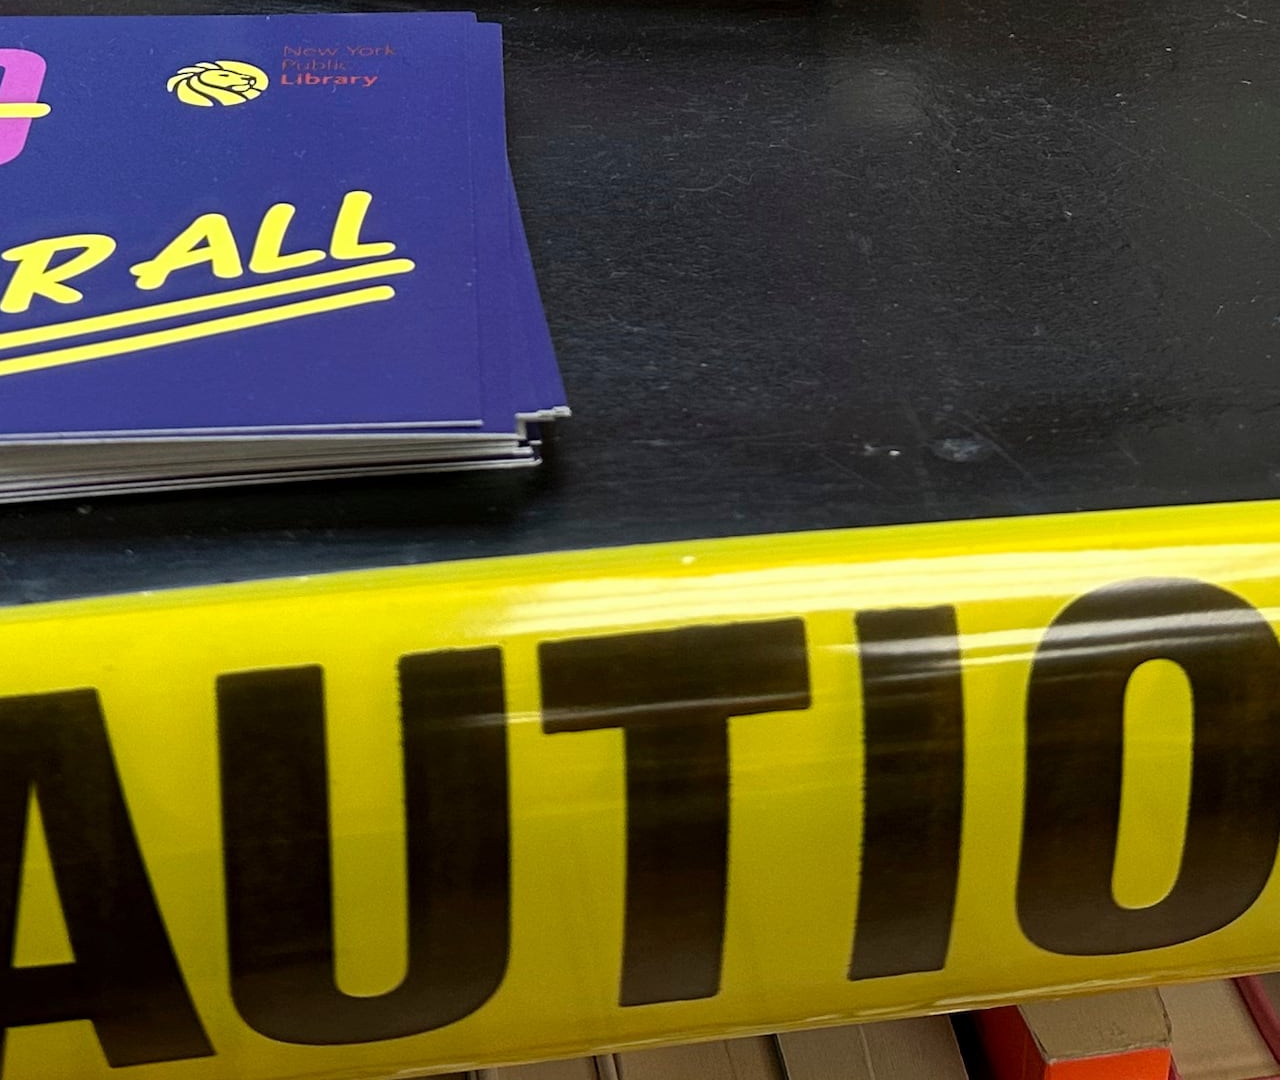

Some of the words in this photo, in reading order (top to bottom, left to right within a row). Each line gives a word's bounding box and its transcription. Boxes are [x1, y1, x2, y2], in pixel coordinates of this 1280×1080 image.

[282, 45, 339, 57] New
[346, 41, 397, 56] York
[281, 58, 348, 72] Public
[280, 72, 379, 87] Library
[129, 189, 397, 291] ALL
